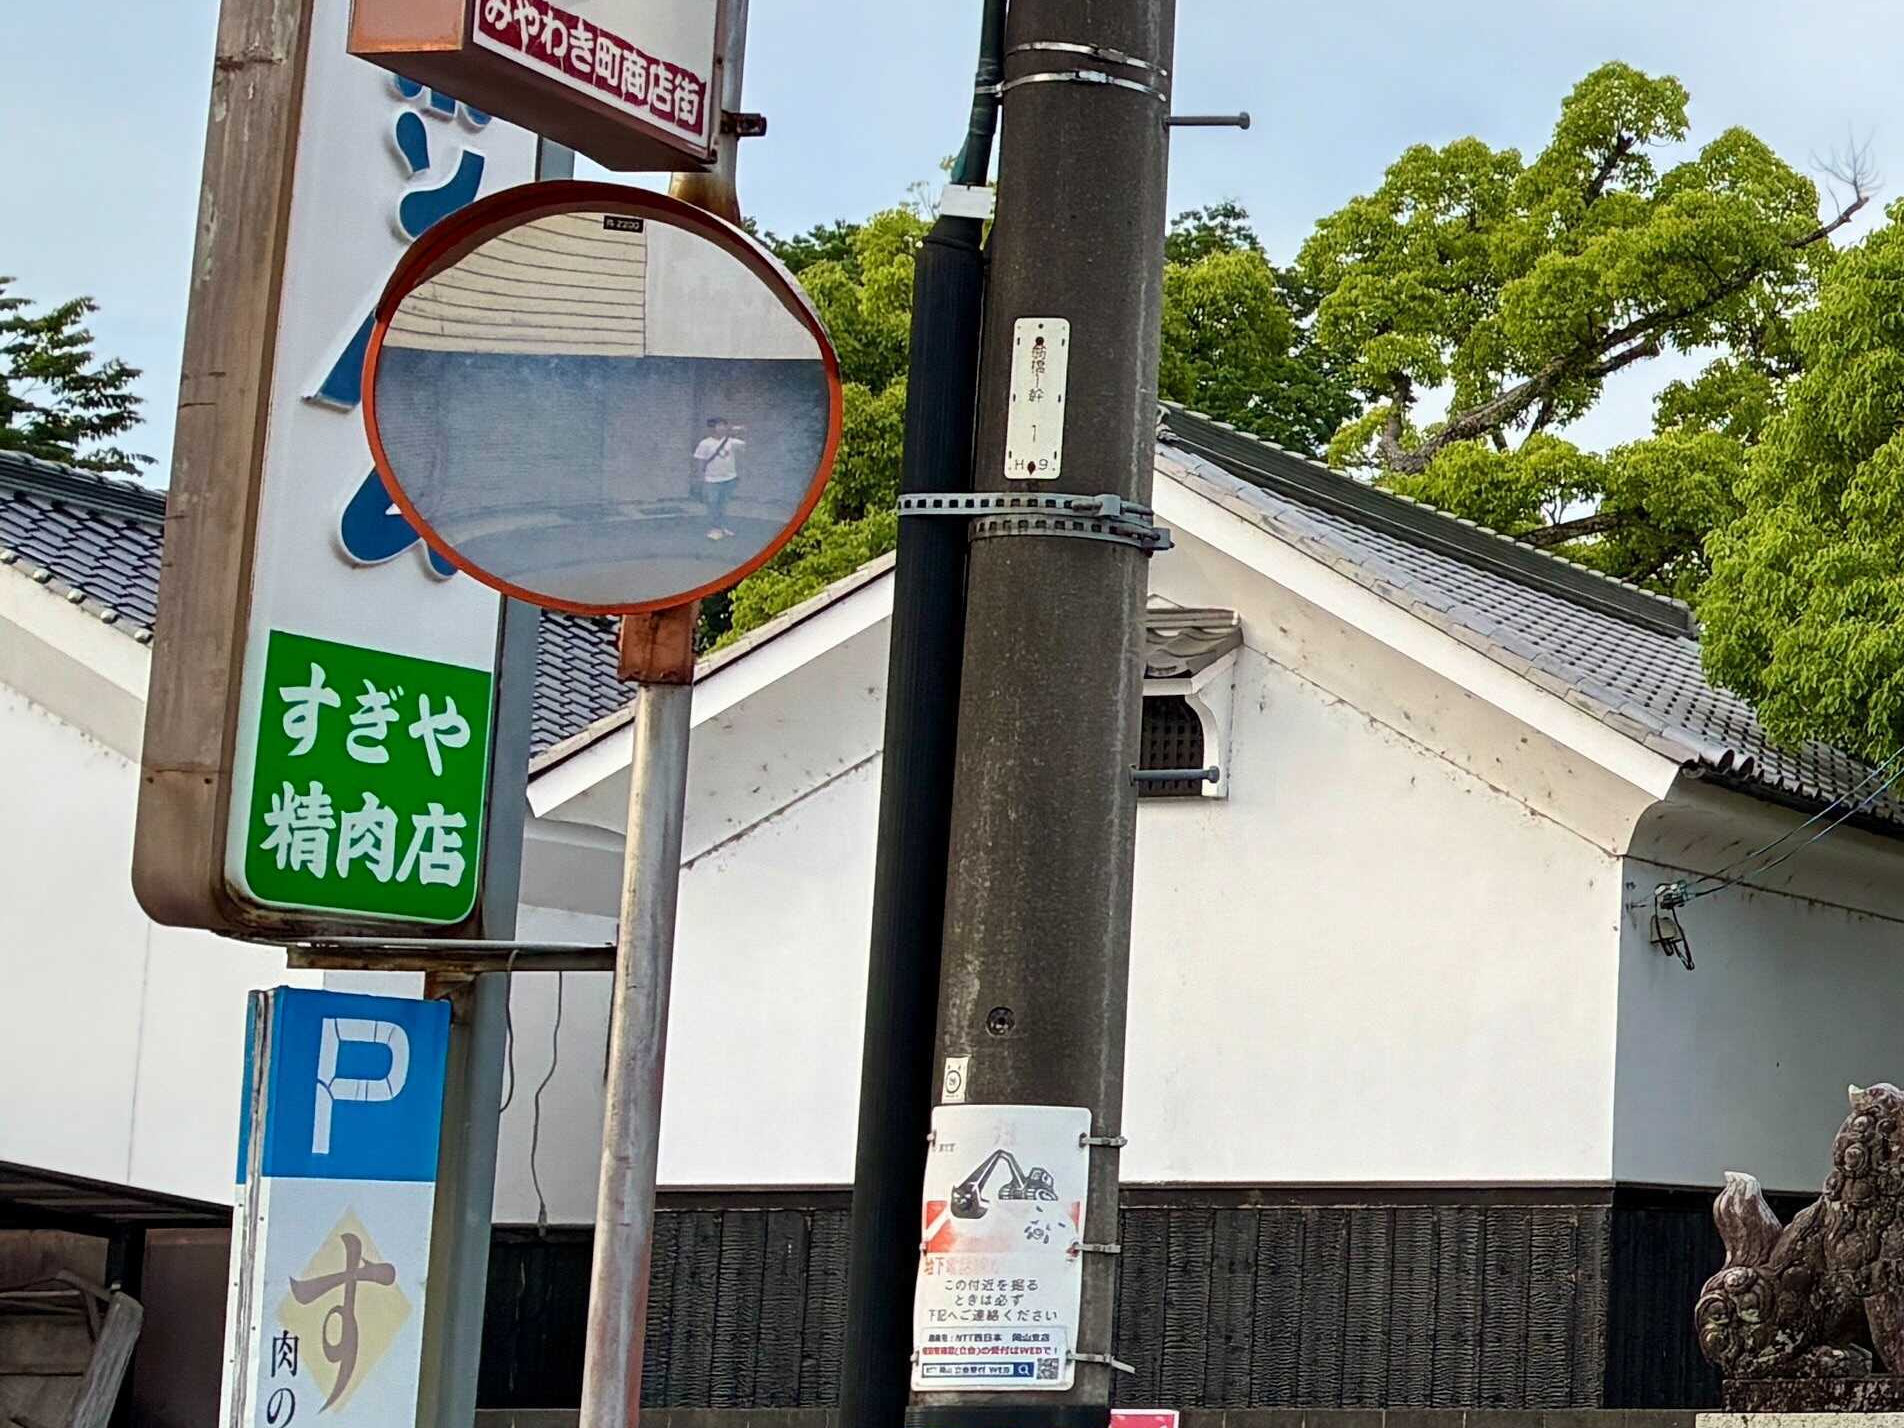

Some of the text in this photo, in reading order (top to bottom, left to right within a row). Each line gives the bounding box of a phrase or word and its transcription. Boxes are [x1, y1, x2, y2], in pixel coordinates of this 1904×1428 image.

[278, 662, 471, 776] すぎや
[260, 780, 469, 887] 精肉店
[311, 1018, 409, 1155] P
[945, 1279, 1038, 1291] この付近を掘る
[954, 1294, 1024, 1306] ときは必ず
[929, 1309, 1057, 1321] 下記へご連絡ください
